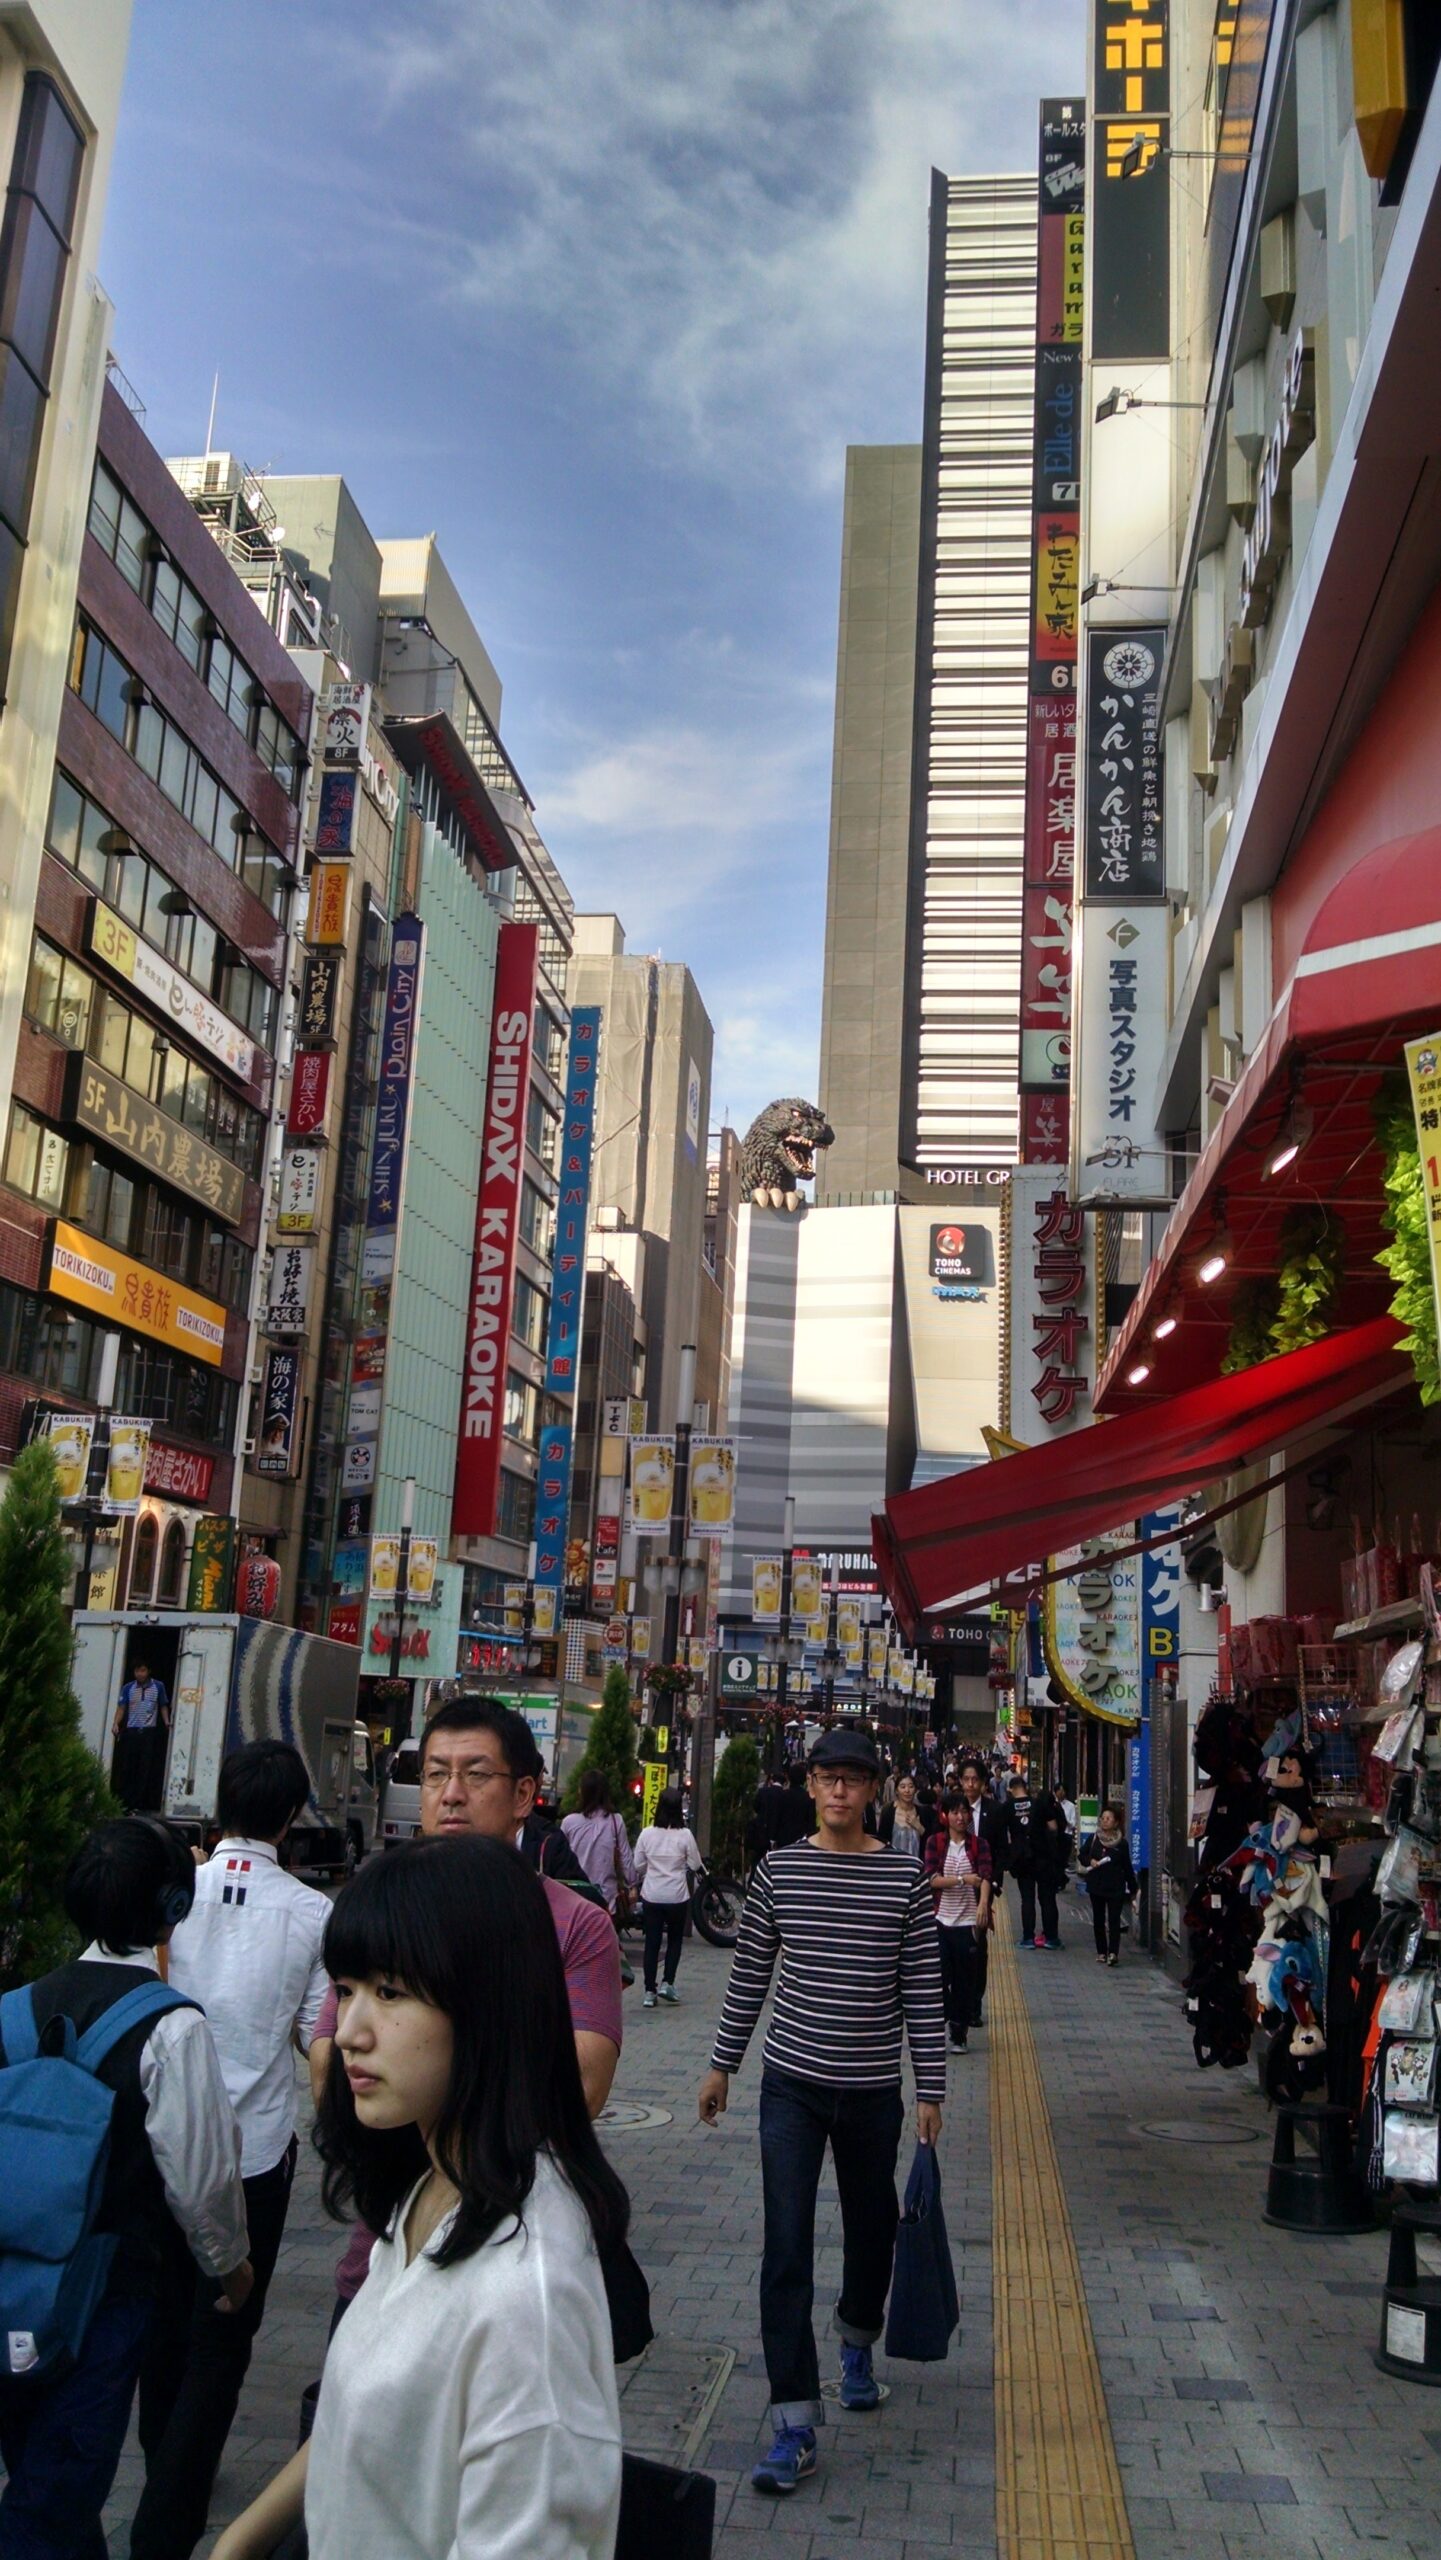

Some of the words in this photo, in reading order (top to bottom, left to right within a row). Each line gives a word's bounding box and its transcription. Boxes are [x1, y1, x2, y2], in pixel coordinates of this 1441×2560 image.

[1043, 352, 1073, 363] New
[1045, 383, 1074, 417] de
[1045, 522, 1079, 640] わたみん家
[334, 747, 349, 758] 8F
[1098, 694, 1135, 882] かんかん商店
[101, 919, 129, 961] 3F
[306, 961, 331, 1025] 山内農場
[1109, 959, 1137, 1122] 写真スタジオ
[83, 1075, 108, 1116] 5F
[297, 1056, 321, 1126] 焼肉屋さかい
[486, 1010, 528, 1185] SHIDAX
[105, 1090, 223, 1204] 山内農場
[927, 1169, 983, 1185] HOTEL
[288, 1215, 306, 1227] 3F
[54, 1246, 110, 1289] TORIKIZOKU
[934, 1258, 962, 1267] TOHO
[934, 1267, 972, 1275] CINEMAS
[178, 1309, 220, 1344] TORIKIZOKU
[464, 1207, 508, 1439] KARAOKE
[1031, 1190, 1088, 1424] カラオケ
[270, 1356, 292, 1410] 海の家
[539, 1444, 564, 1573] カラオケ
[331, 1621, 357, 1633] アダム
[948, 1627, 983, 1640] TOHO
